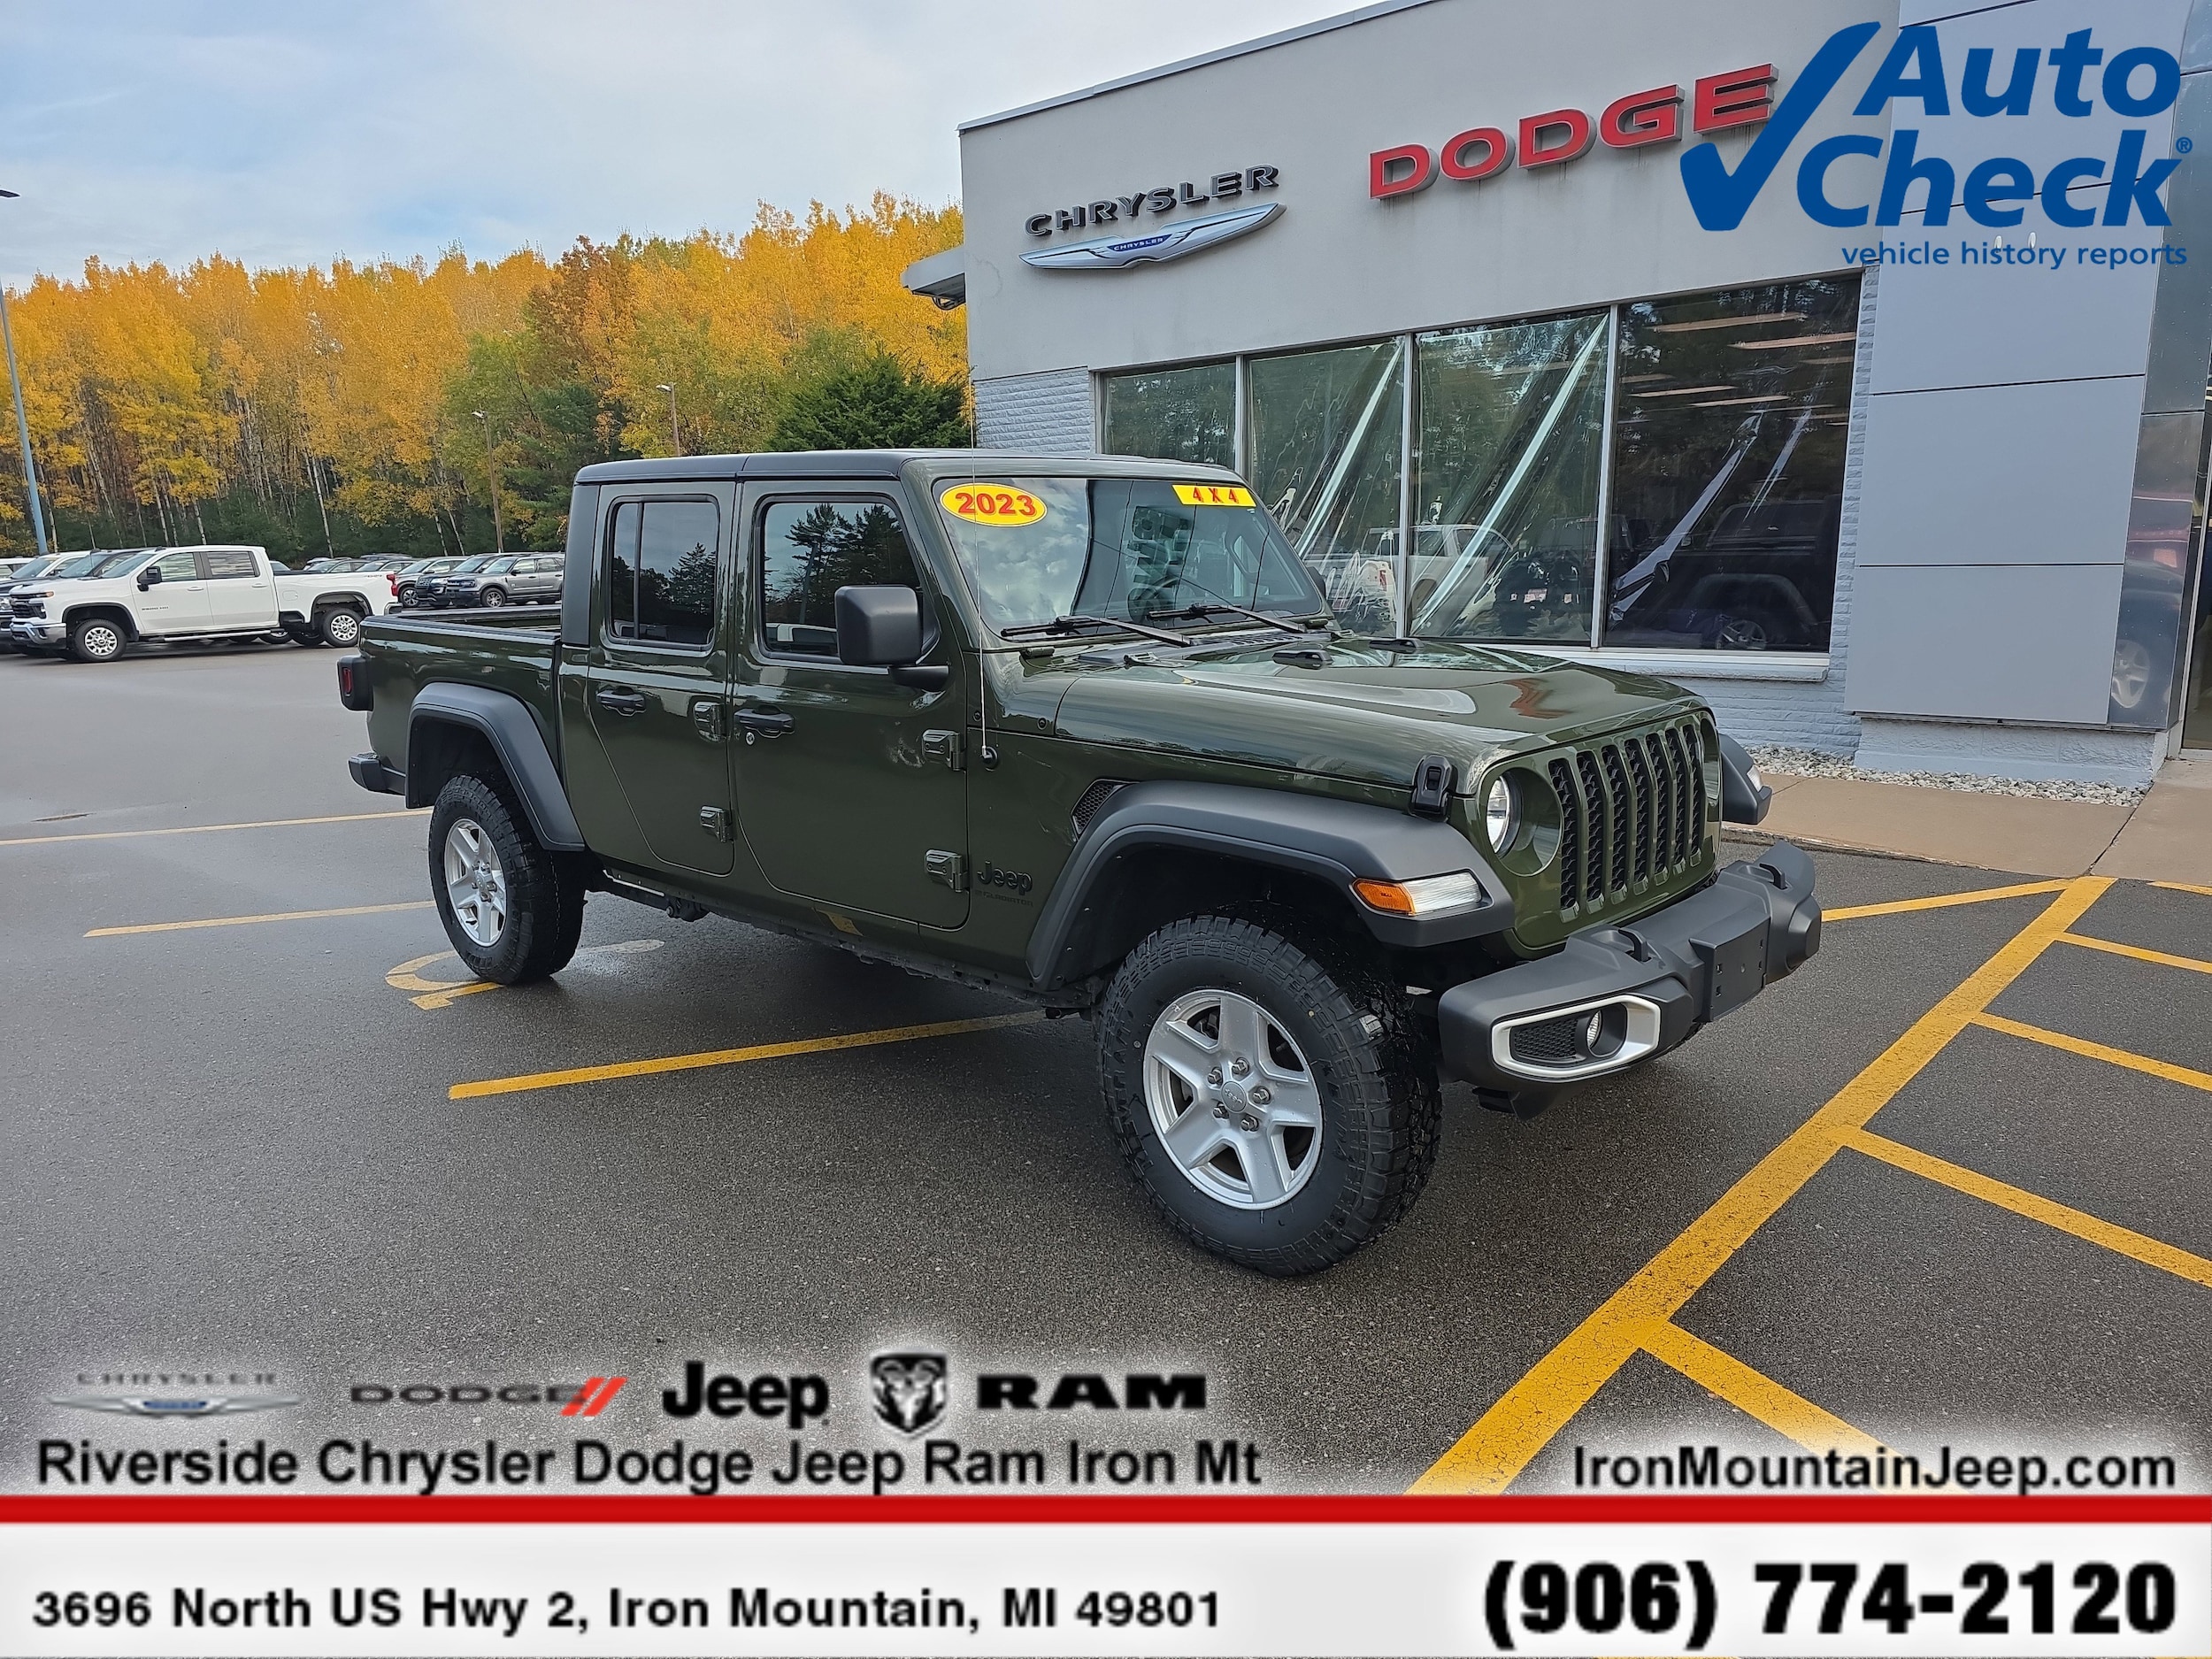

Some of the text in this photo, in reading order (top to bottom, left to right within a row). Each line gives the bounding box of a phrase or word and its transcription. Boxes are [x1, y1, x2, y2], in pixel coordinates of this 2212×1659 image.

[1369, 63, 1778, 200] DODGE
[1025, 165, 1279, 237] CHRYSLER
[1113, 236, 1164, 251] CHRYSLER
[954, 492, 1038, 518] 2023
[977, 860, 1033, 896] Jeep
